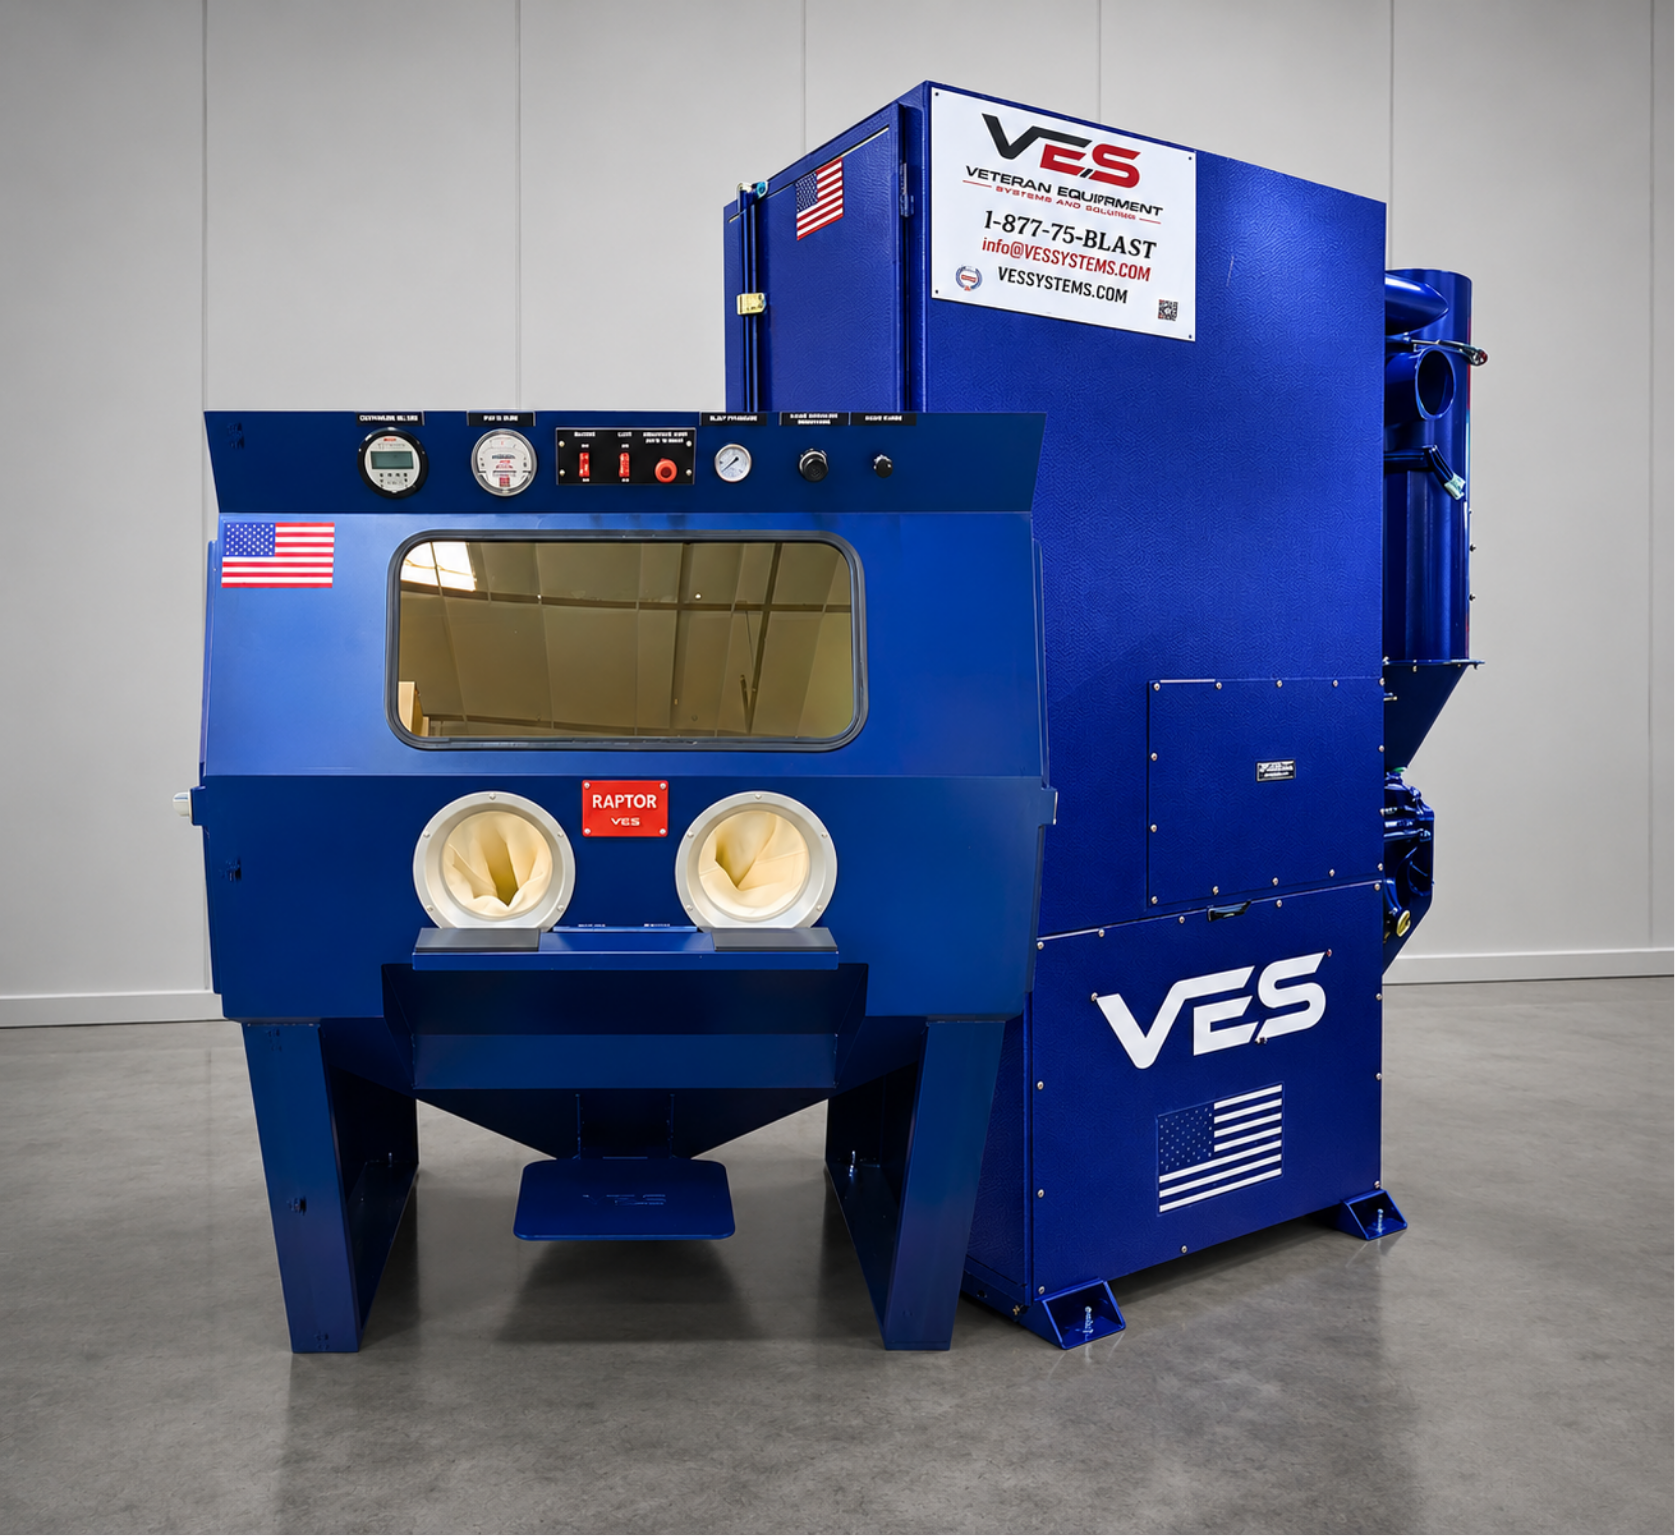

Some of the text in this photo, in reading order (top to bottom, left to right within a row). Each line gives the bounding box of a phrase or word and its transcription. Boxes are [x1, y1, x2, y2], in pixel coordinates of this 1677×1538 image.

[981, 113, 1141, 189] VES
[965, 165, 1052, 194] VETERAN
[995, 186, 1053, 203] SYSTEMS
[1056, 199, 1081, 210] AND
[983, 209, 1158, 260] 1-877-75-BLAST
[981, 236, 1152, 283] info@VESSYSTEMS.COM
[997, 265, 1129, 305] VESSYSTEMS.COM
[592, 794, 657, 809] RAPTOR
[610, 817, 640, 827] VES
[1096, 951, 1327, 1069] VES
